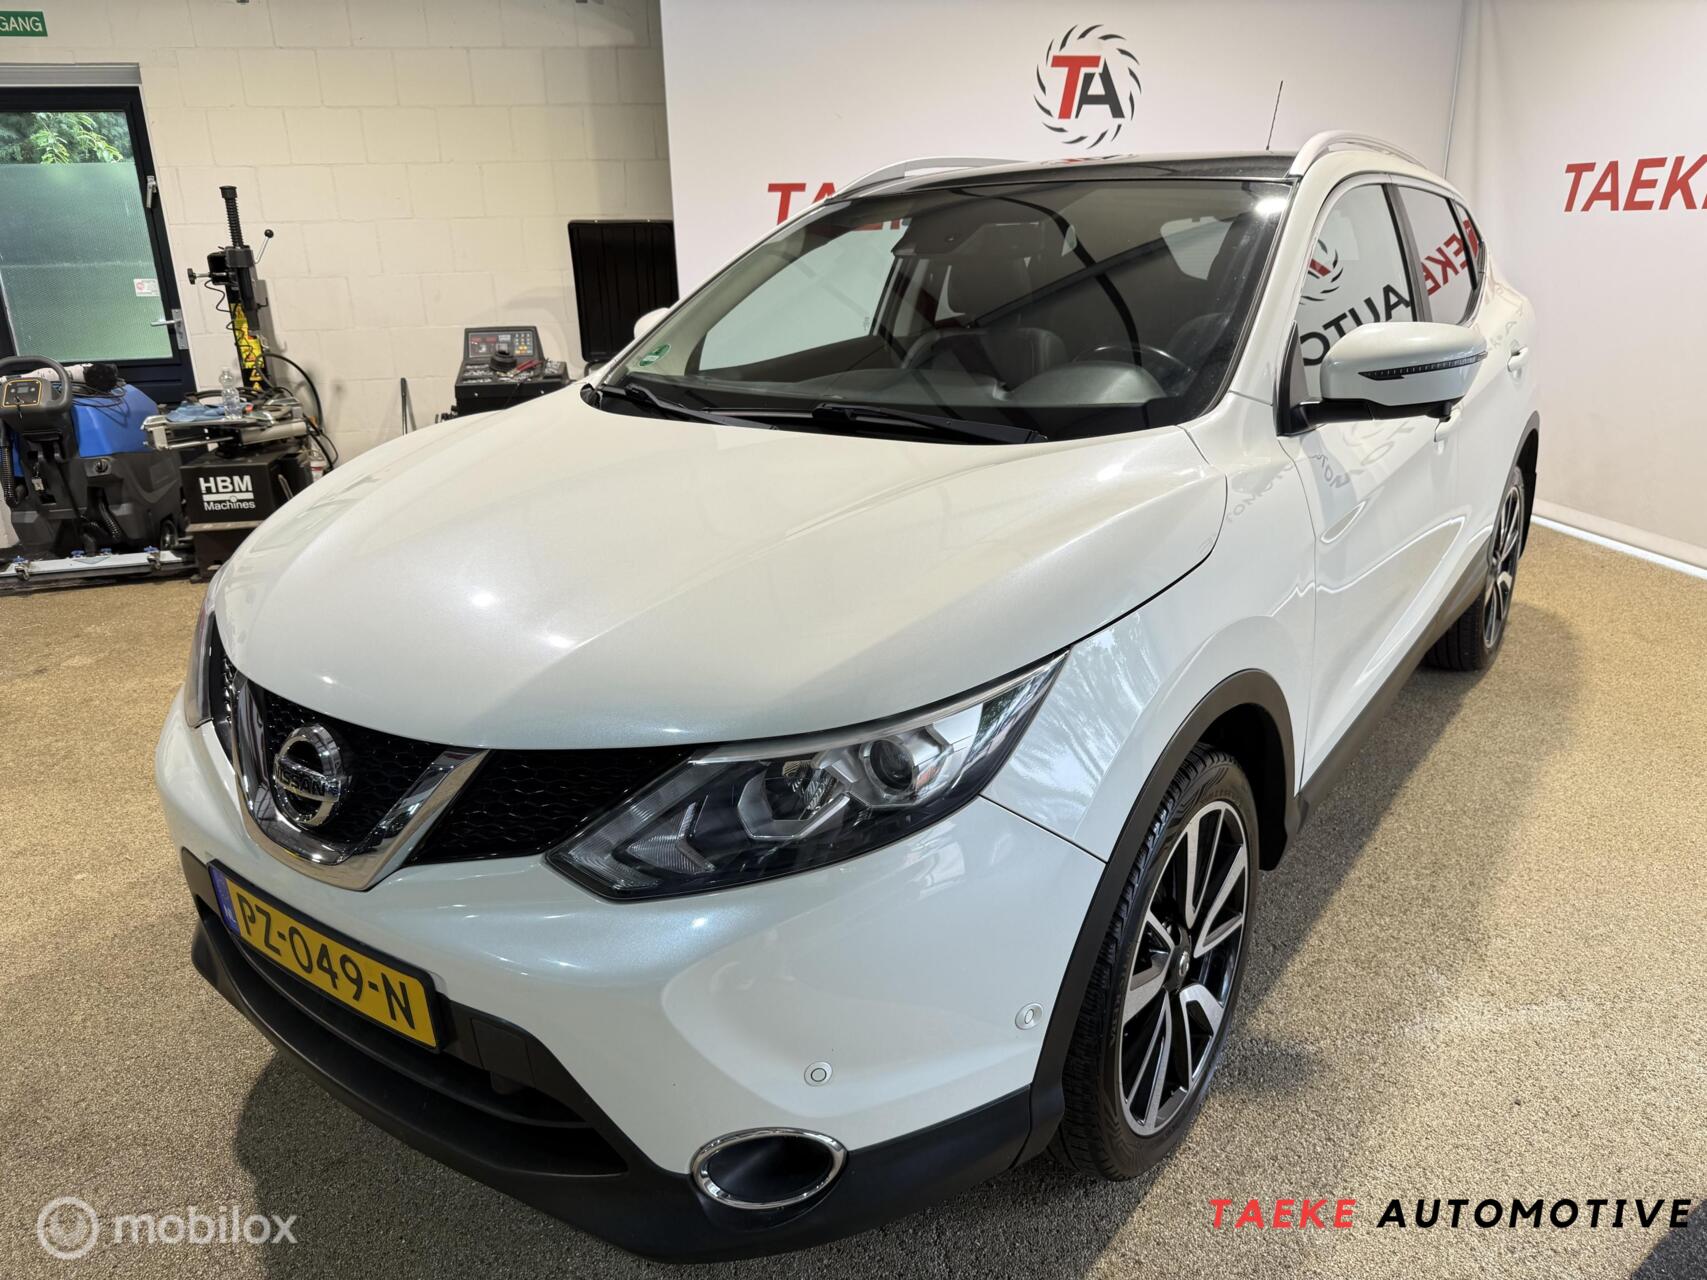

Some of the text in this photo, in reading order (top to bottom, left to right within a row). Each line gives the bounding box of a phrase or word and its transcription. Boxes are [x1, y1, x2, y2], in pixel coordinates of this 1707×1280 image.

[0, 16, 43, 32] GANG
[1050, 55, 1125, 119] TA
[1564, 153, 1707, 213] TAEK
[199, 474, 253, 493] HBM
[203, 500, 256, 511] Machines
[236, 892, 416, 1030] PZ-049-N
